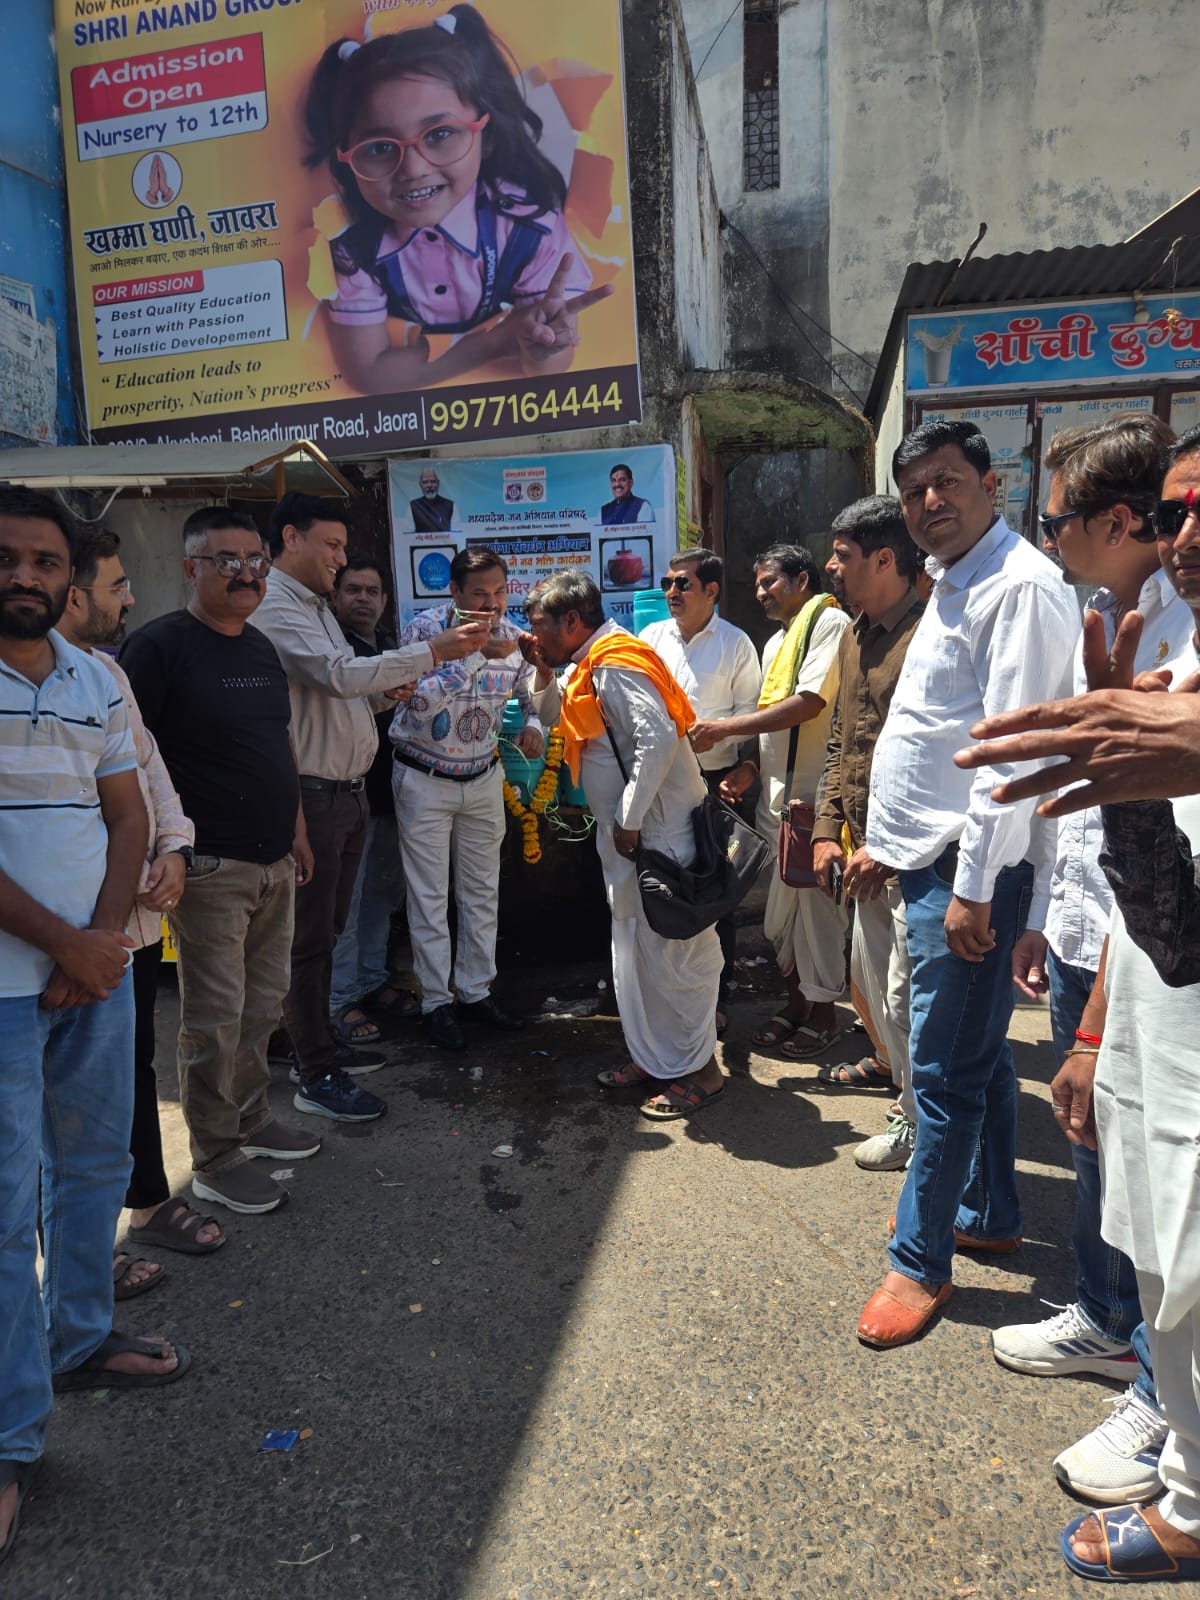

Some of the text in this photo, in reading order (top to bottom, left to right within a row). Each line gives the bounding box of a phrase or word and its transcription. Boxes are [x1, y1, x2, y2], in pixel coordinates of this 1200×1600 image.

[74, 14, 128, 46] SHRI
[136, 0, 218, 35] ANAND
[75, 0, 105, 17] Now
[89, 46, 244, 89] Admission
[122, 80, 203, 110] Open
[84, 101, 258, 150] Nursery to 12th
[84, 202, 278, 254] खम्मा घणी, जावरा
[113, 256, 144, 269] मिलकर
[172, 250, 187, 262] एक
[189, 247, 209, 258] कदम
[211, 242, 234, 254] शिक्षा
[236, 240, 248, 250] की
[95, 275, 194, 302] OUR MISSION
[111, 291, 271, 322] Best Quality Education
[112, 313, 245, 340] Learn with Passion
[114, 326, 272, 358] Holistic Developement
[115, 367, 196, 390] Education
[200, 360, 242, 379] leads
[247, 359, 262, 373] to
[102, 396, 184, 421] prosperity,
[230, 421, 319, 443] Bahadurpur
[323, 412, 369, 440] Road,
[373, 410, 418, 434] Jaora
[430, 381, 623, 433] 9977164444
[524, 509, 556, 521] अभियान
[547, 535, 589, 551] अभियान
